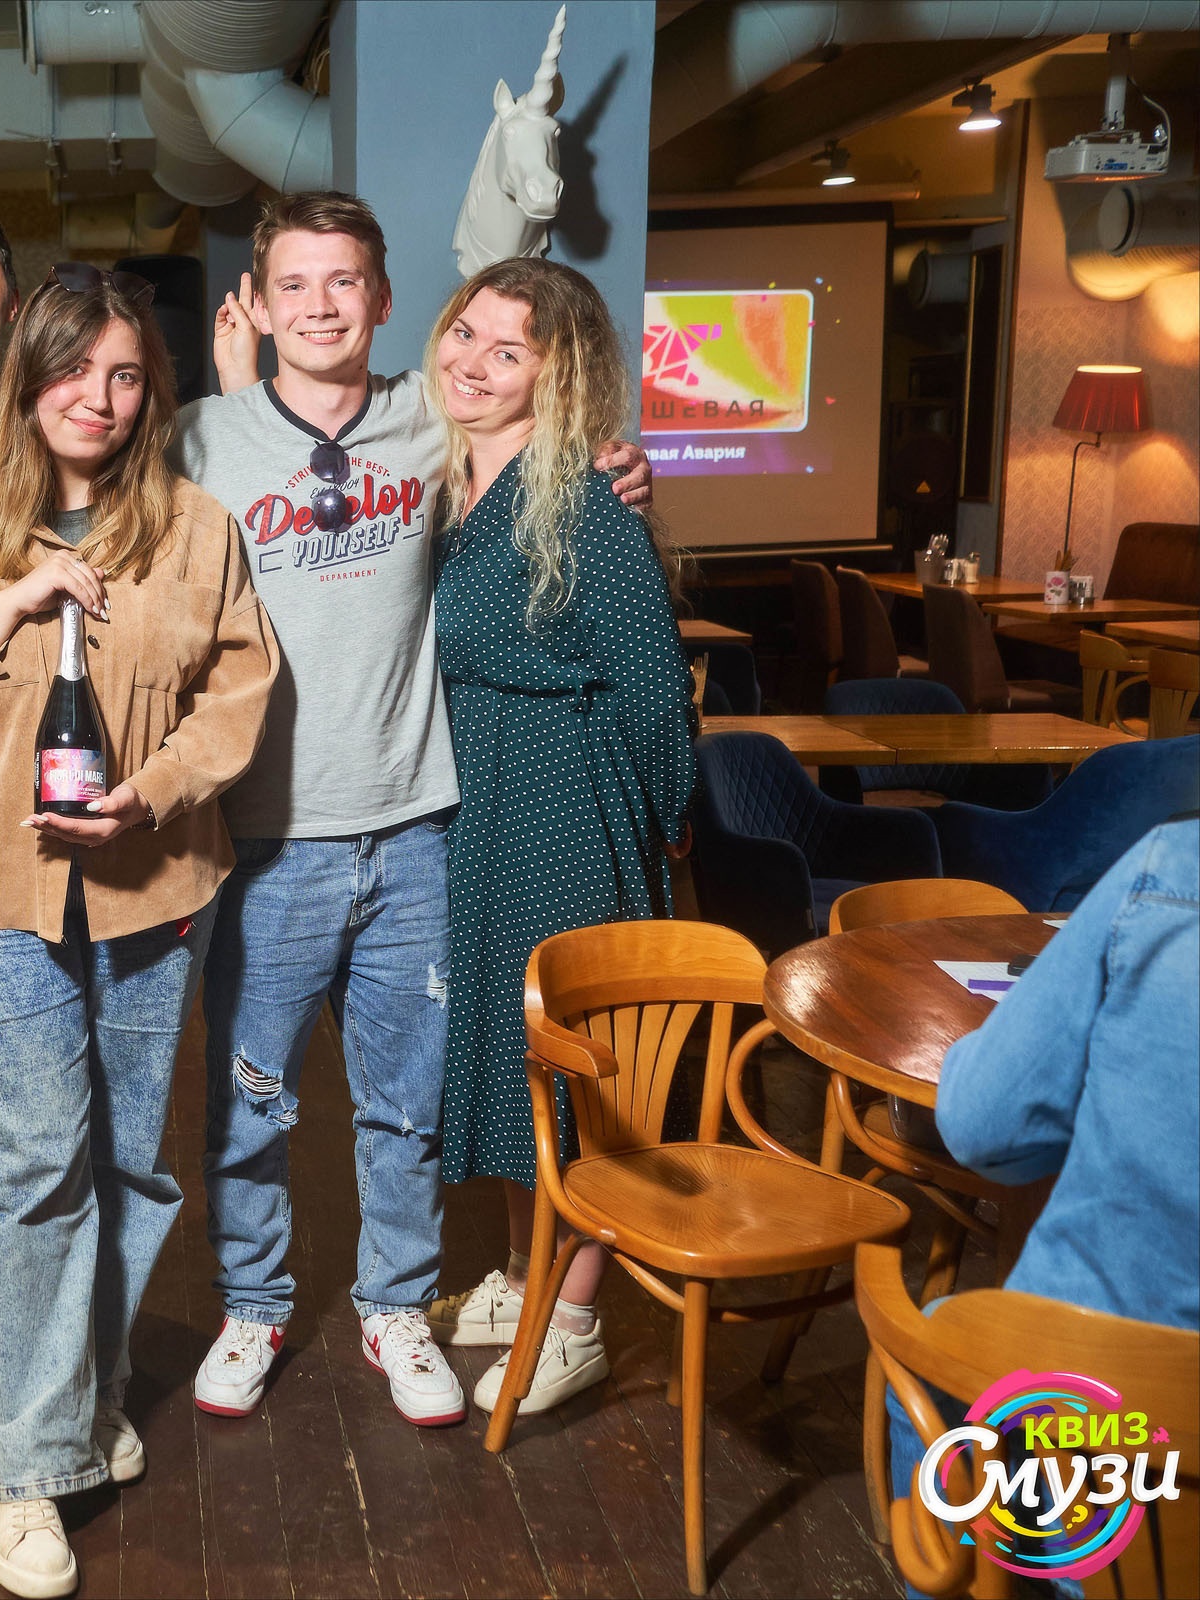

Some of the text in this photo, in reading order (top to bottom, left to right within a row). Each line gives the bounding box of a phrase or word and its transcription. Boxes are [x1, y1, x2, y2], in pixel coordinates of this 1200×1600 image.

[682, 444, 746, 463] Авария
[244, 473, 426, 545] Deelop
[291, 516, 401, 568] YOURSELF
[319, 568, 377, 583] DEPARTMENT
[85, 770, 104, 784] MARE
